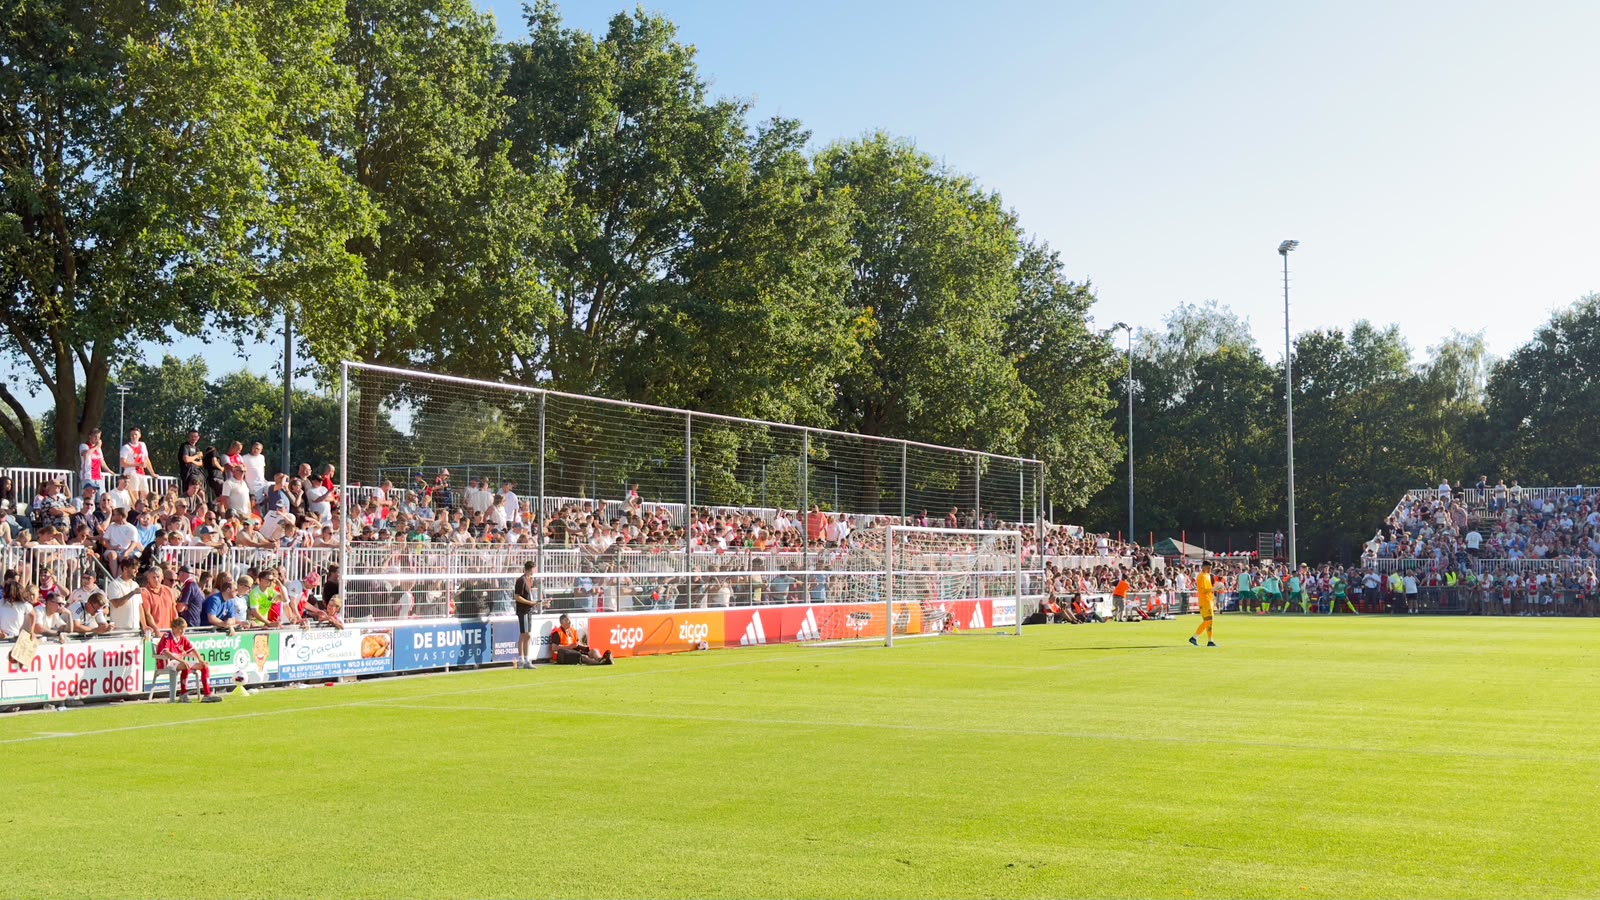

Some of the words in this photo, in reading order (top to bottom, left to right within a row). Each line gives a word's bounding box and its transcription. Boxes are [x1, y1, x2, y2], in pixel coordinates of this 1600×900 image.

[413, 633, 433, 649] DE
[436, 629, 482, 647] BUNTE
[610, 625, 644, 649] ziggo
[679, 620, 708, 643] ziggo
[48, 645, 97, 670] vloek
[103, 644, 140, 667] mist
[208, 649, 231, 662] Arts
[296, 639, 343, 662] Gracia
[413, 647, 482, 662] VASTGOED
[51, 673, 97, 698] ieder
[102, 669, 140, 694] doel
